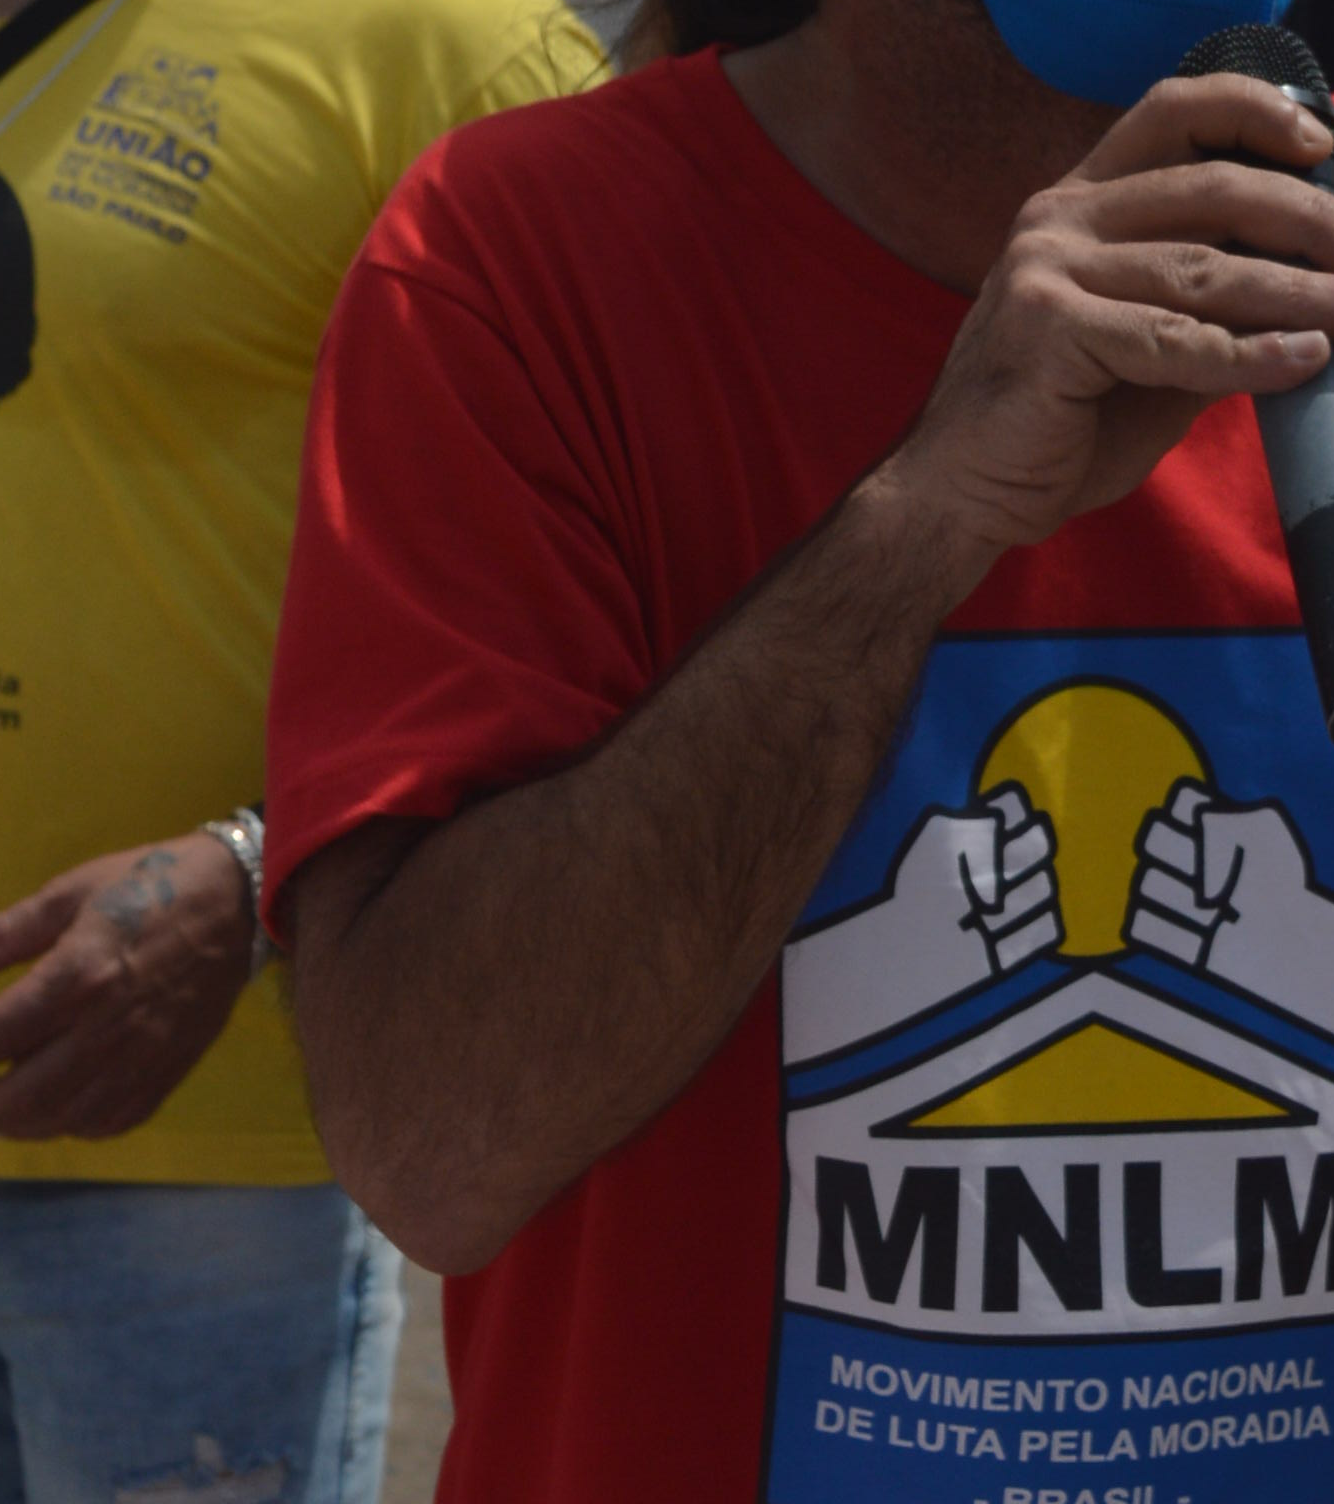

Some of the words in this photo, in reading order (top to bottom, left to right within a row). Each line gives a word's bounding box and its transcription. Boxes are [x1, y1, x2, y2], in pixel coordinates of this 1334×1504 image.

[830, 1354, 1109, 1413] MOVIMENTO
[1122, 1358, 1324, 1409] NACIONAL
[814, 1400, 874, 1441] DE
[887, 1416, 1006, 1460] LUTA
[1018, 1423, 1140, 1463] PELA
[1148, 1405, 1332, 1459] MORADIA
